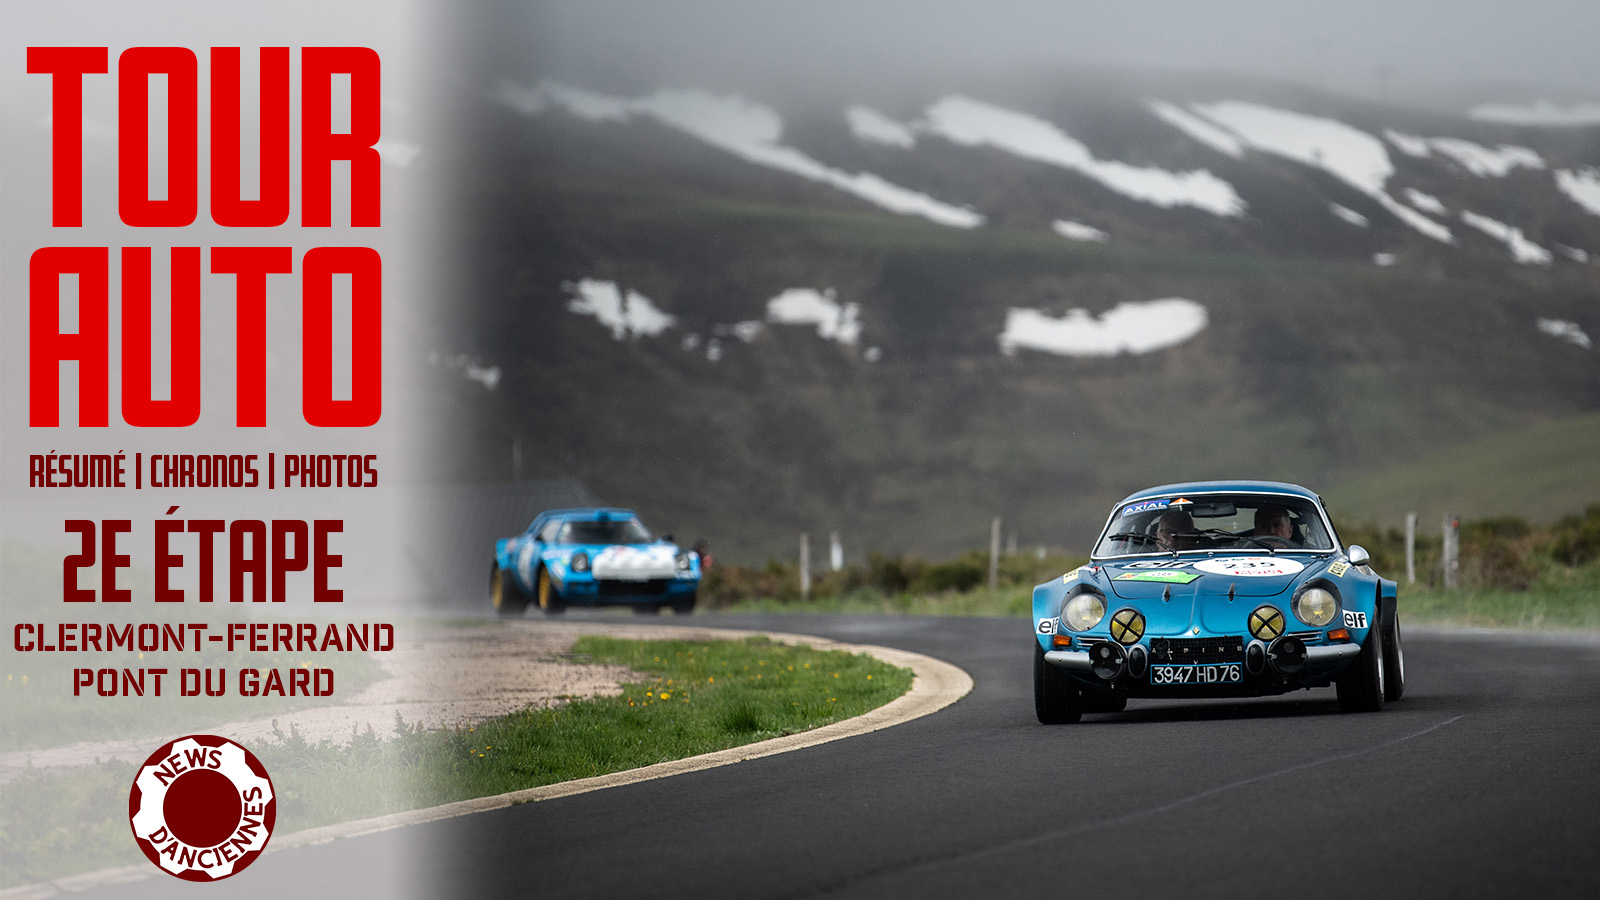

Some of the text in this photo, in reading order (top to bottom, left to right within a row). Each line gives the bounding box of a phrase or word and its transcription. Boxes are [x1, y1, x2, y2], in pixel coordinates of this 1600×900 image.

[1124, 502, 1167, 514] AXIAL
[1038, 617, 1059, 634] elf
[1344, 612, 1366, 628] elf
[1154, 665, 1240, 683] 3947 HD 76
